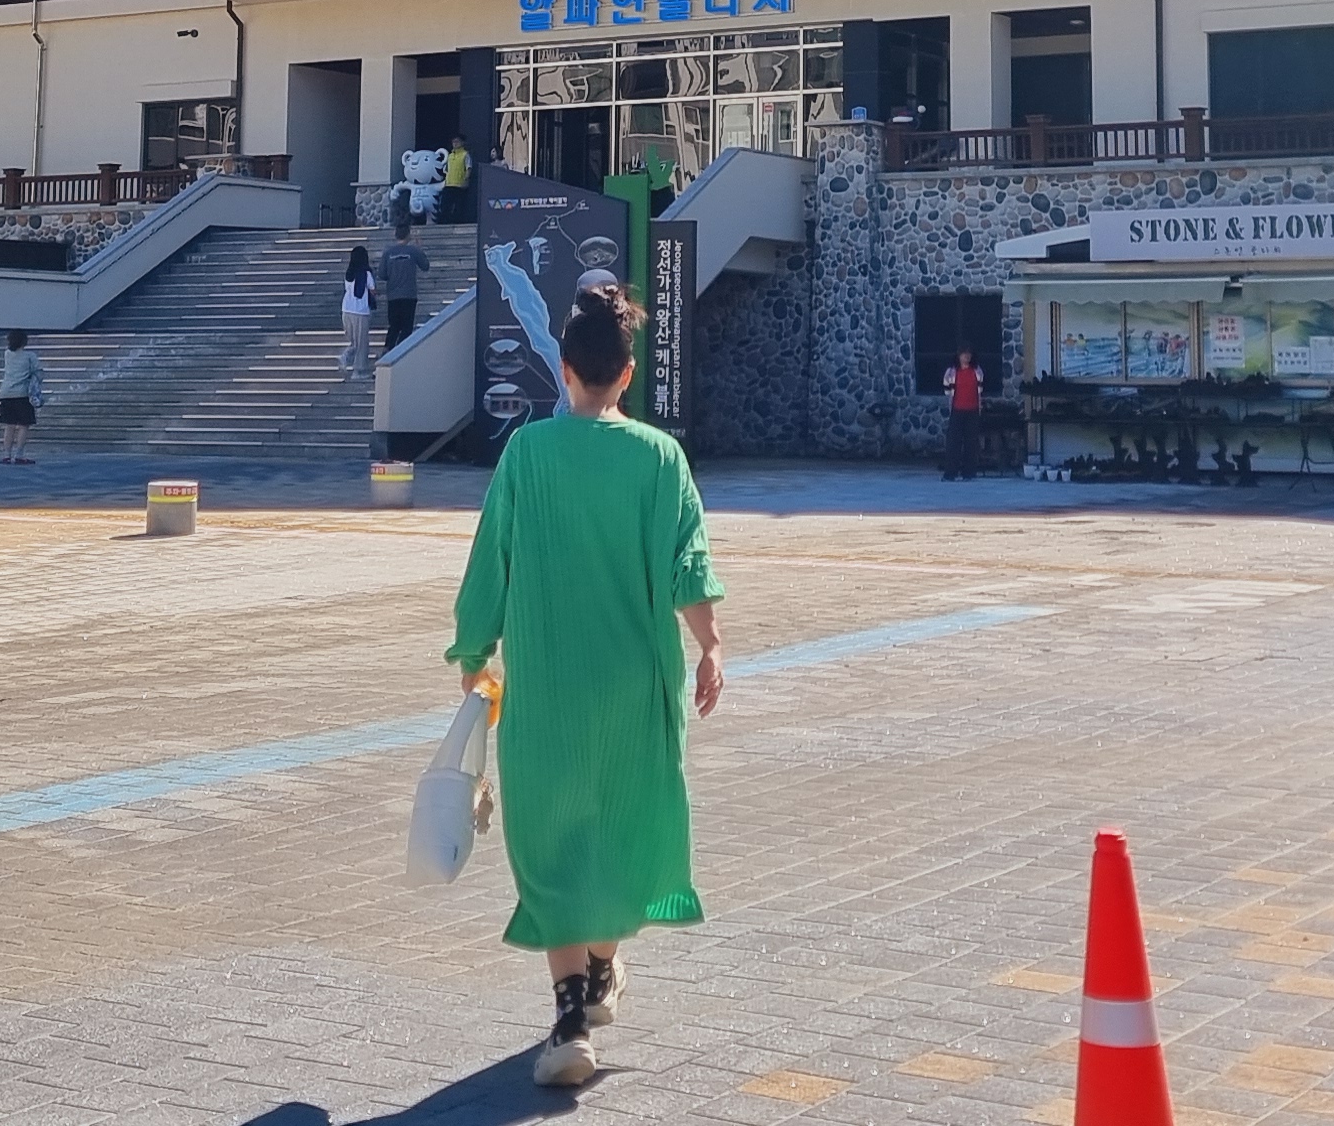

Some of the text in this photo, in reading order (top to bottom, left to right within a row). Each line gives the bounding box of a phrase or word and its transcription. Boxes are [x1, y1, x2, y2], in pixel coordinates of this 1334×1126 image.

[1129, 217, 1217, 243] STONE
[1225, 216, 1245, 241] &
[654, 239, 672, 419] 정선가리왕산 케이블카
